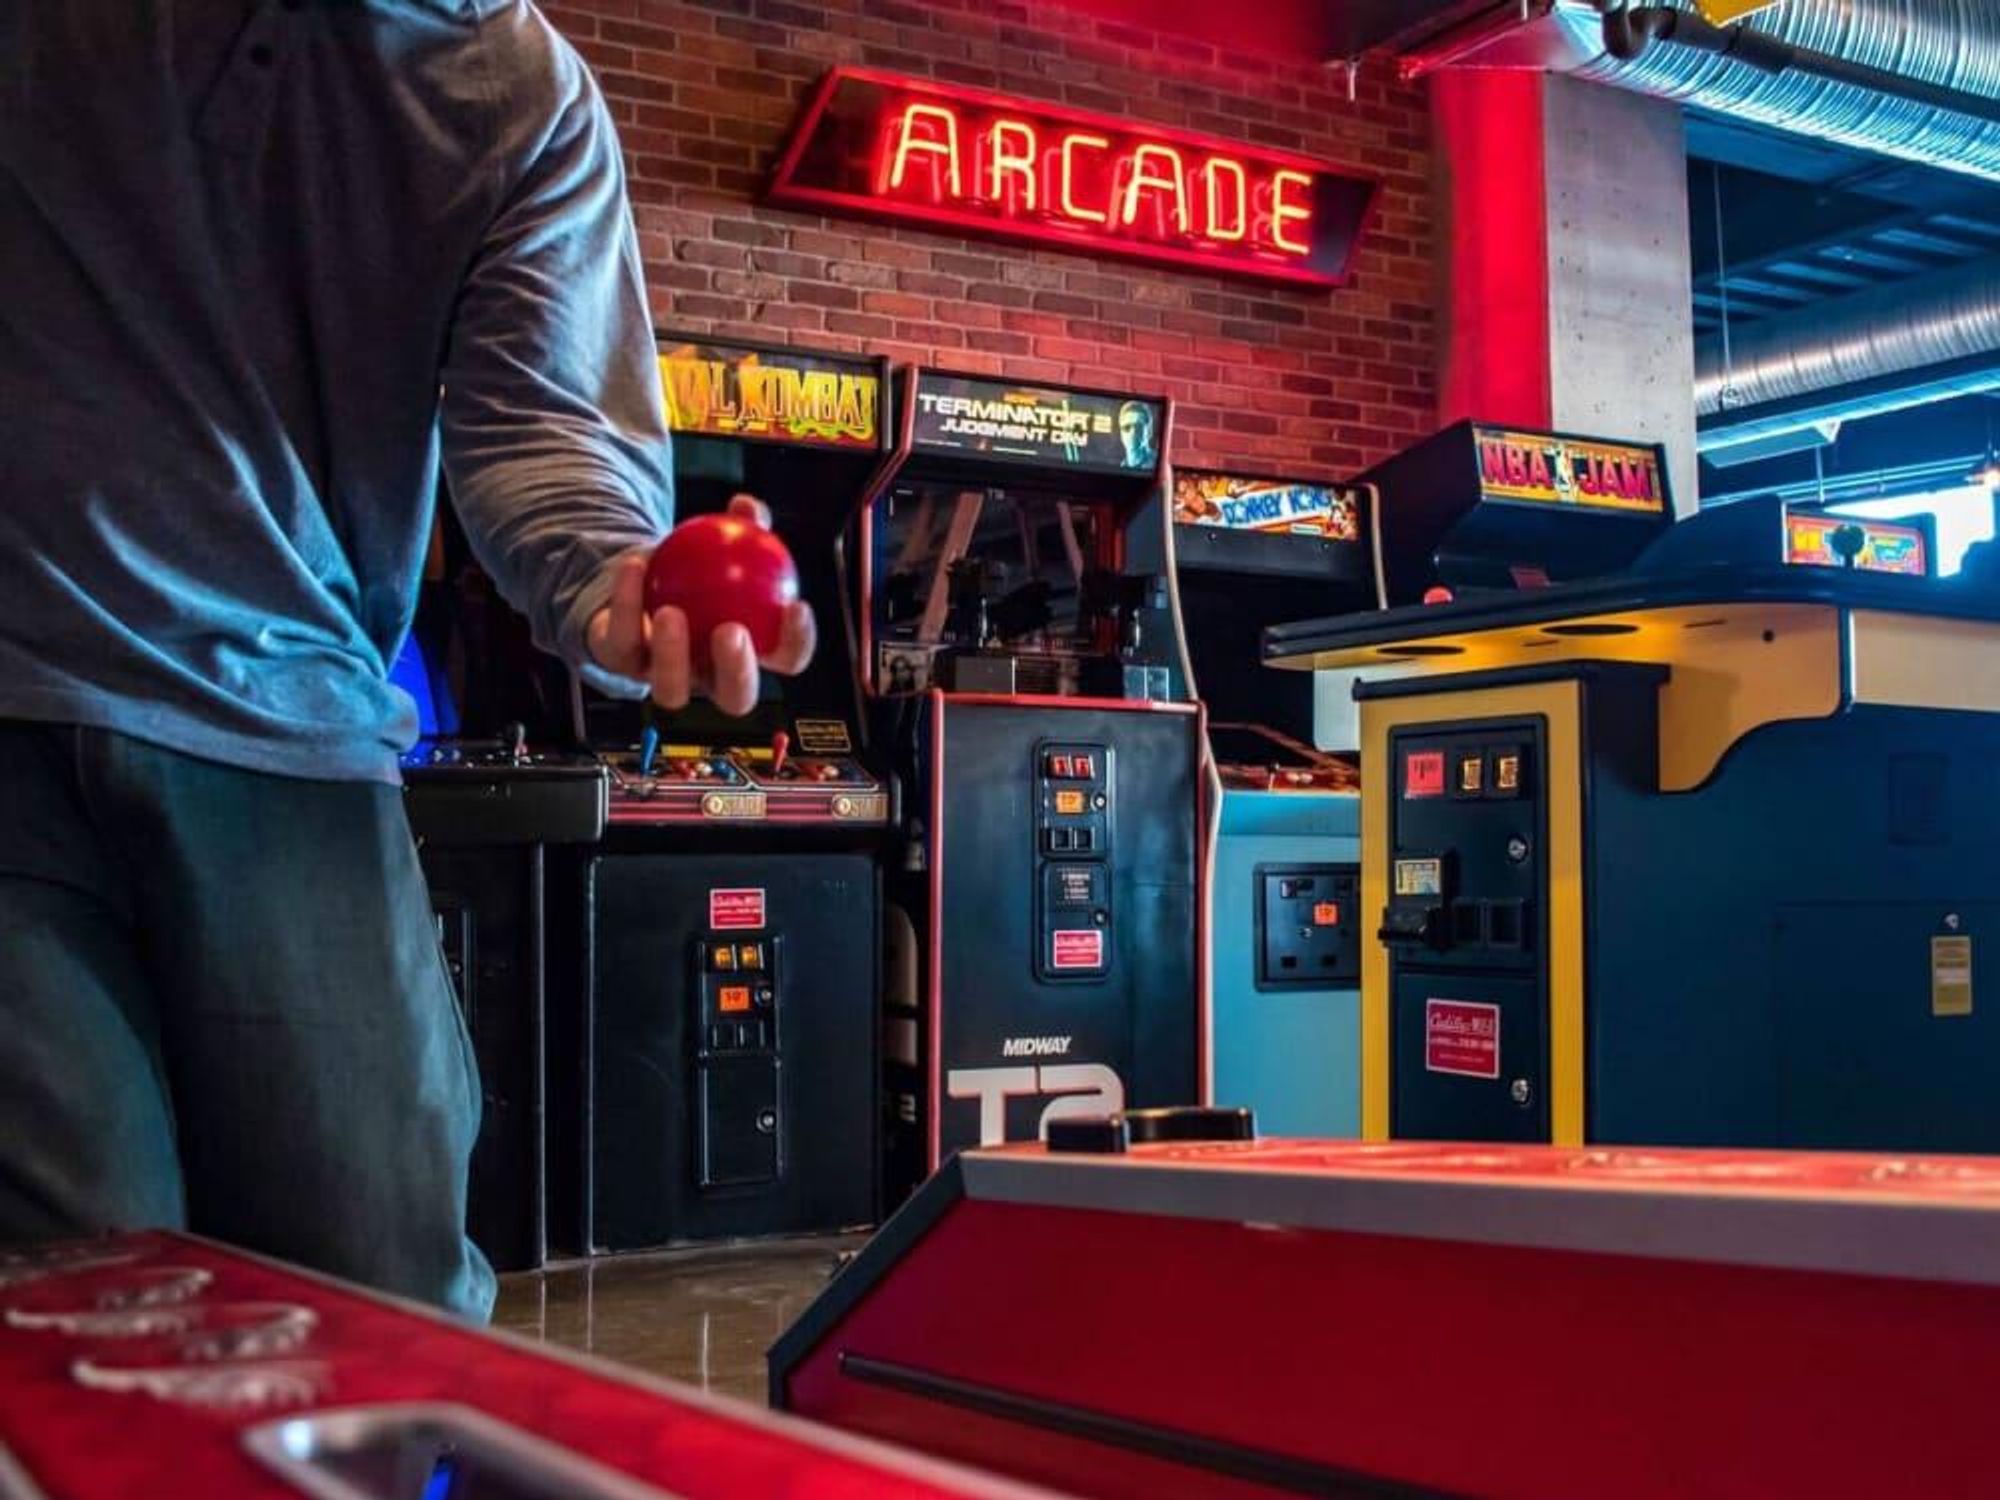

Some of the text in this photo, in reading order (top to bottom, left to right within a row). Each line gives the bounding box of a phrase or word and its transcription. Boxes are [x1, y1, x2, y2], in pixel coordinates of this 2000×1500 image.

[890, 104, 1312, 254] ARCADE
[738, 353, 878, 440] KOMBAT
[918, 393, 1090, 430] TERMINATOR
[1093, 414, 1112, 433] 2
[939, 418, 1088, 446] JUDGMENT DAY
[1482, 441, 1651, 499] NBA JAM
[1222, 492, 1283, 526] DONKEY
[1003, 1036, 1072, 1056] MIDWAY
[948, 1063, 1124, 1147] T2
